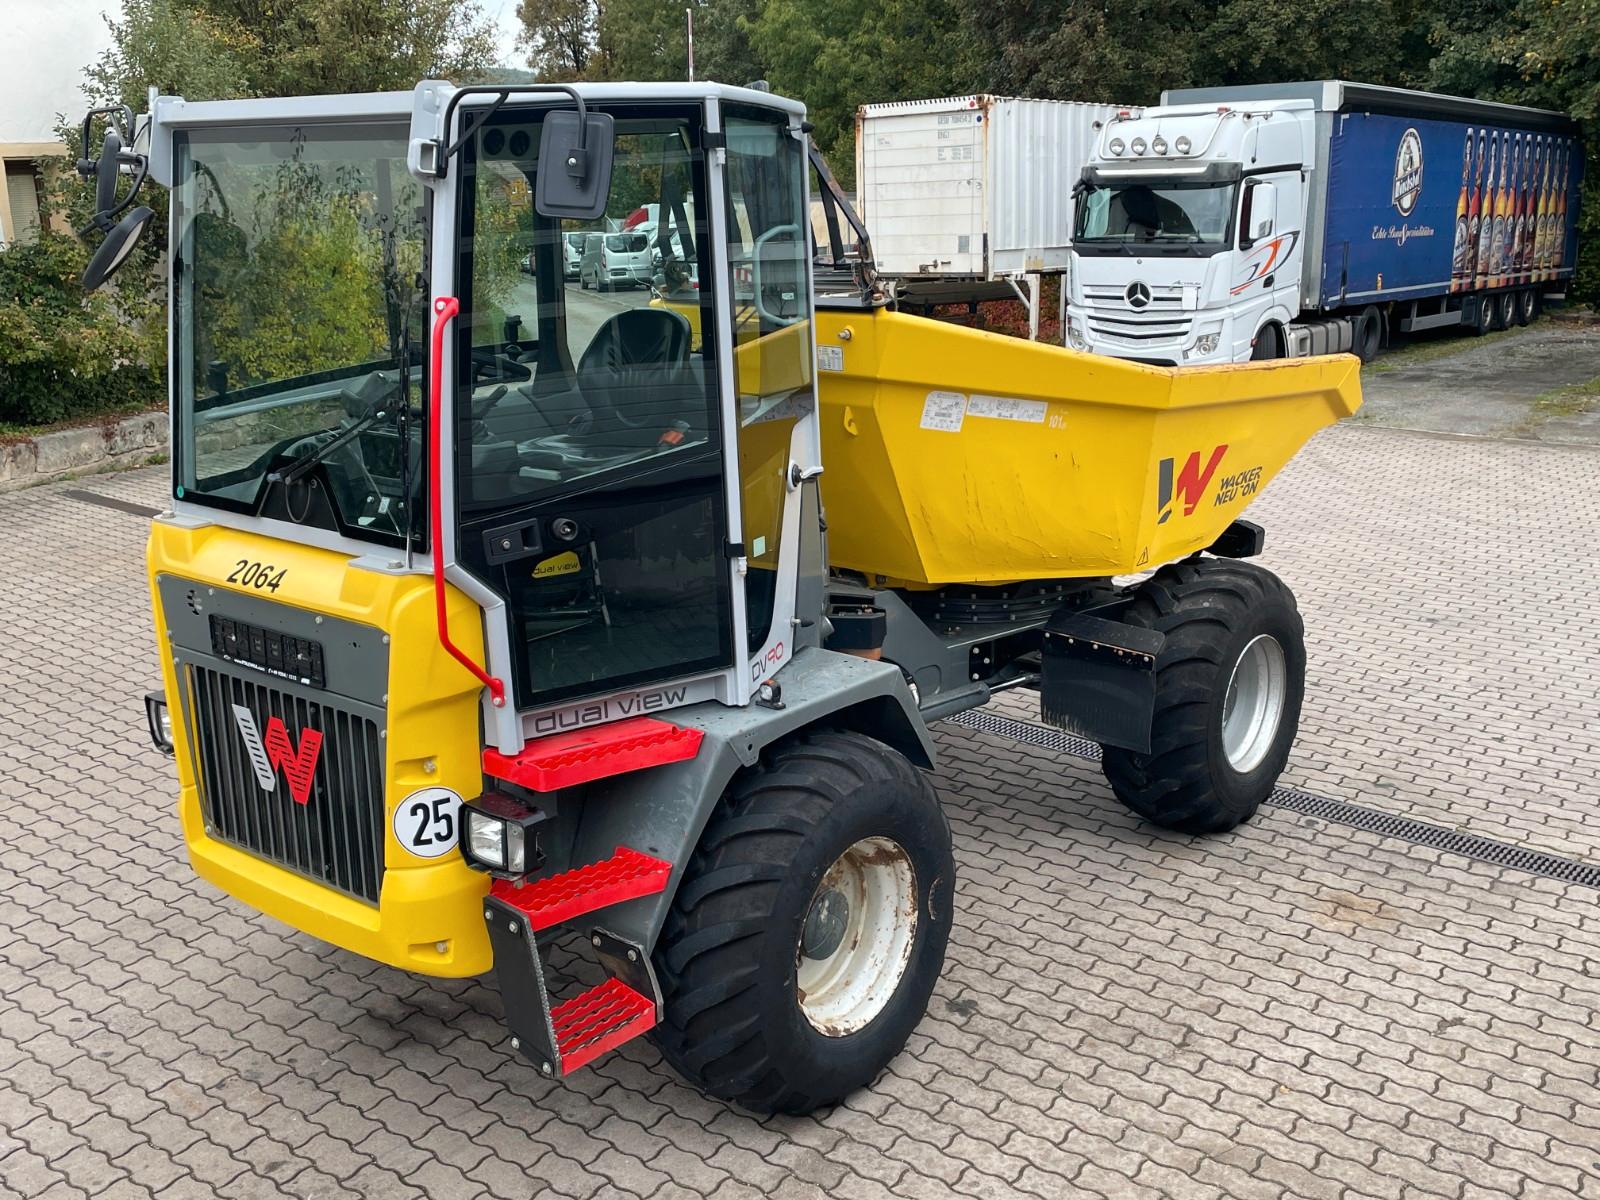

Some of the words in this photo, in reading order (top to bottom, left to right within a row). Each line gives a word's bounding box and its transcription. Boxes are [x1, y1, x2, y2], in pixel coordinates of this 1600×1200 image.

[1213, 480, 1260, 508] NEUON
[1220, 466, 1263, 492] WACKER
[226, 559, 289, 594] 2064
[534, 564, 555, 576] dual
[557, 562, 579, 571] view
[751, 641, 784, 682] DV90
[534, 701, 609, 734] dual
[617, 686, 688, 715] view
[409, 796, 454, 848] 25
